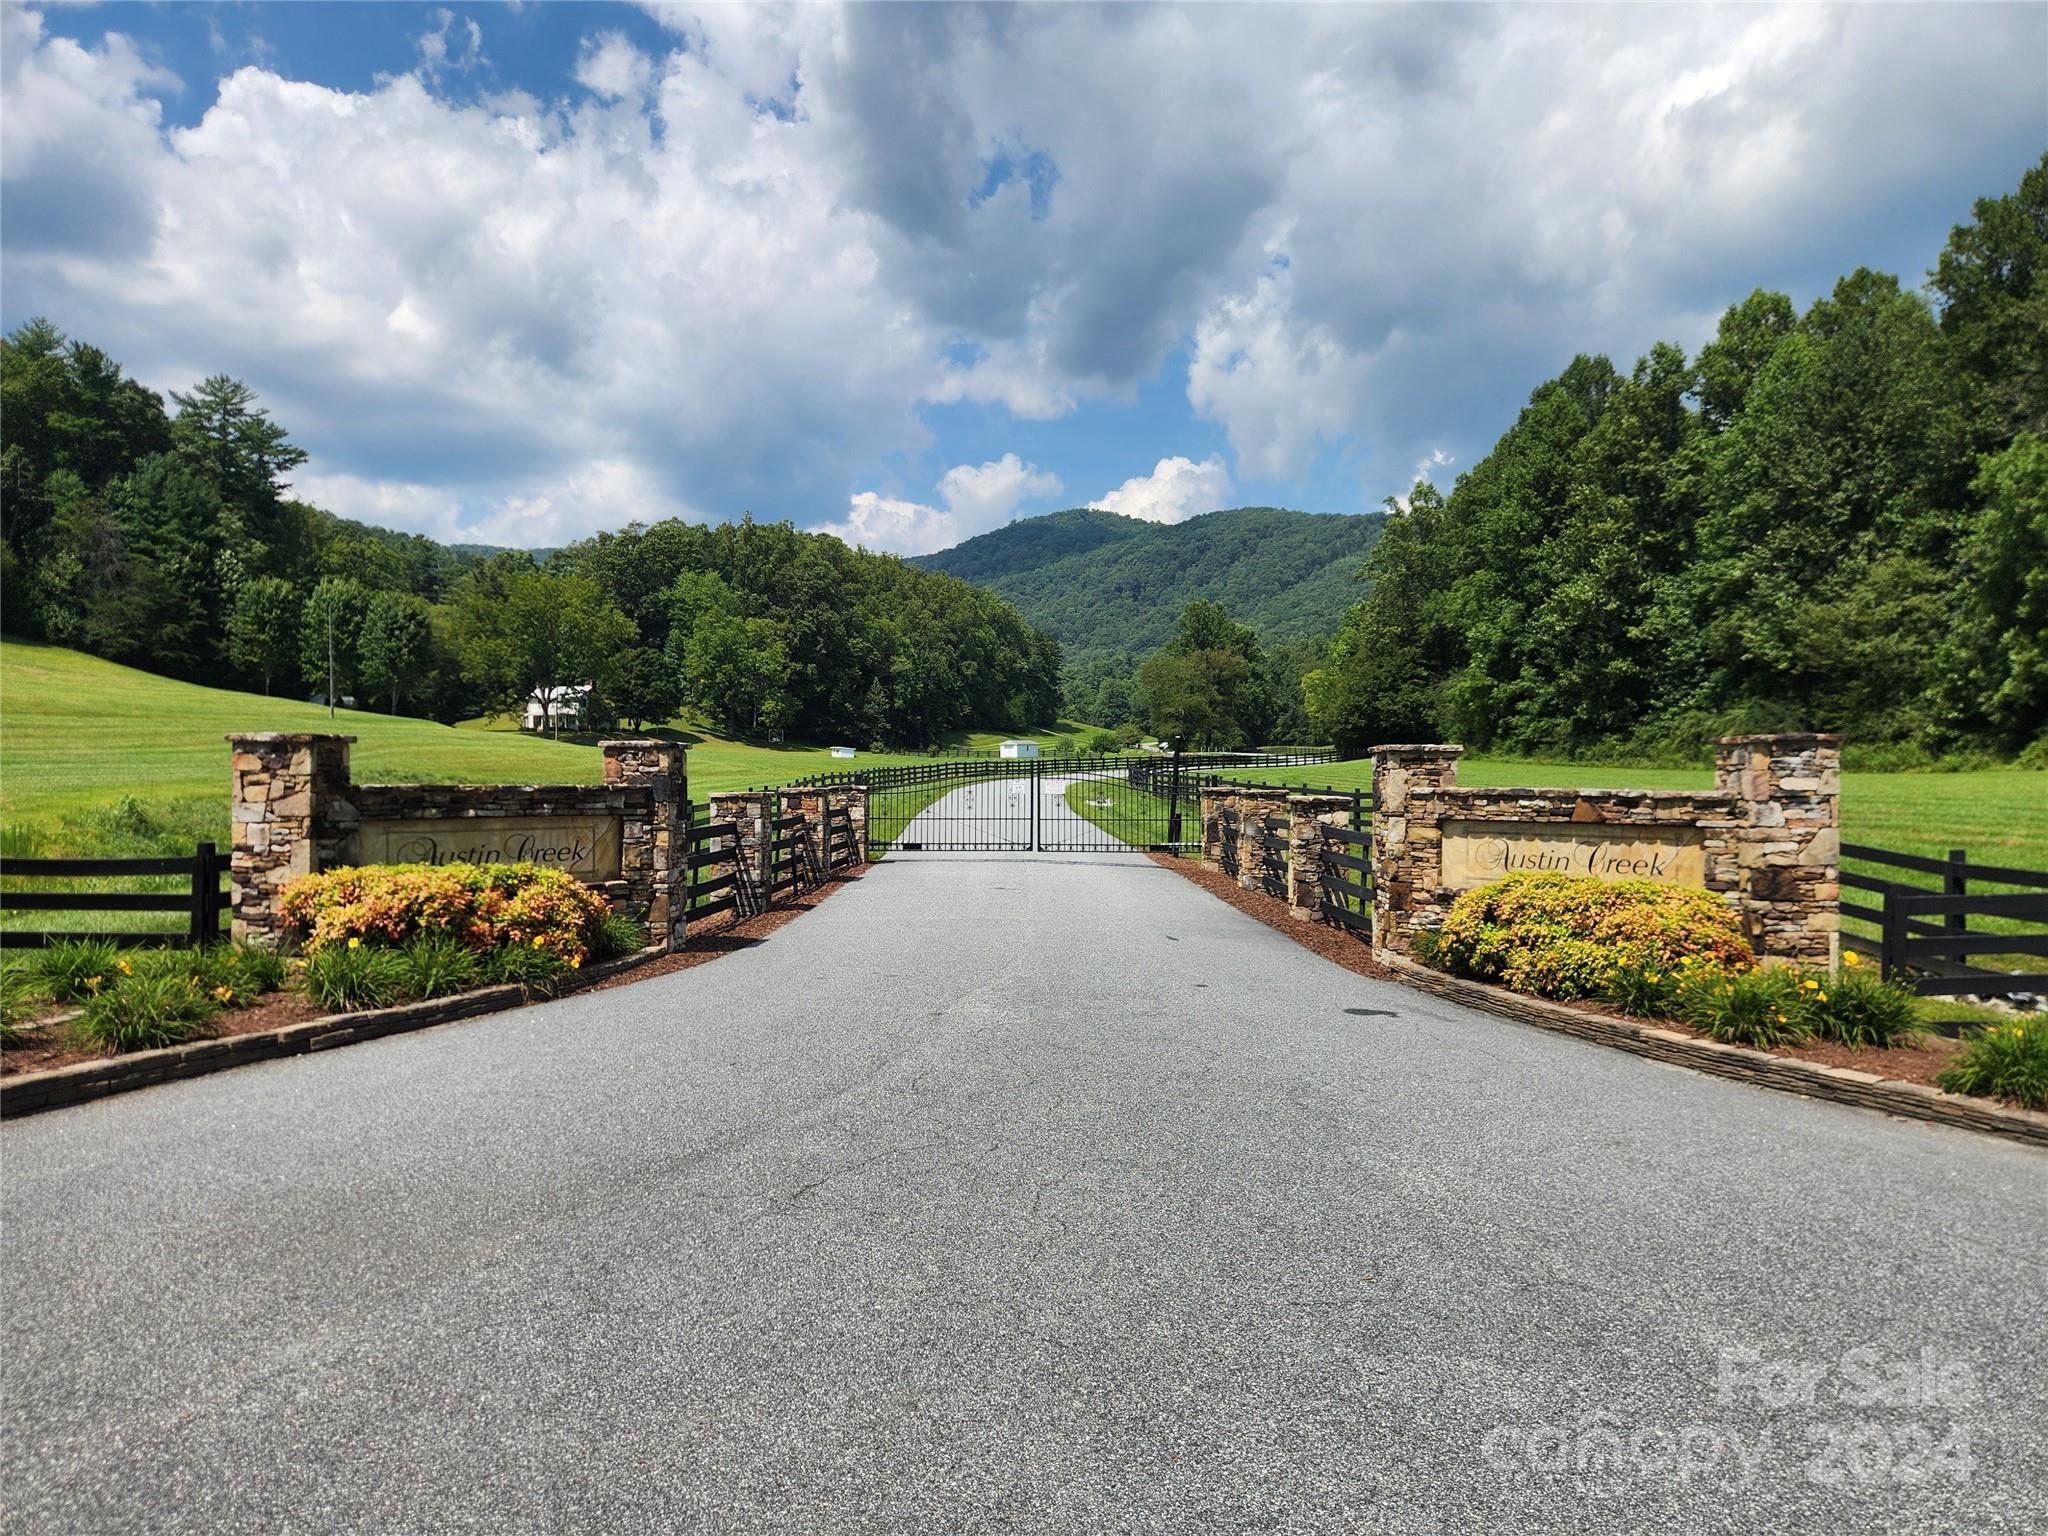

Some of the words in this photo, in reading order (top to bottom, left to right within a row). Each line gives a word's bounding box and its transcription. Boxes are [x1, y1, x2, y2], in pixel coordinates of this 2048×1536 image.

[397, 837, 500, 867] Austin
[504, 832, 592, 868] Creek
[1475, 838, 1570, 874] Austin
[1573, 838, 1672, 878] Creek
